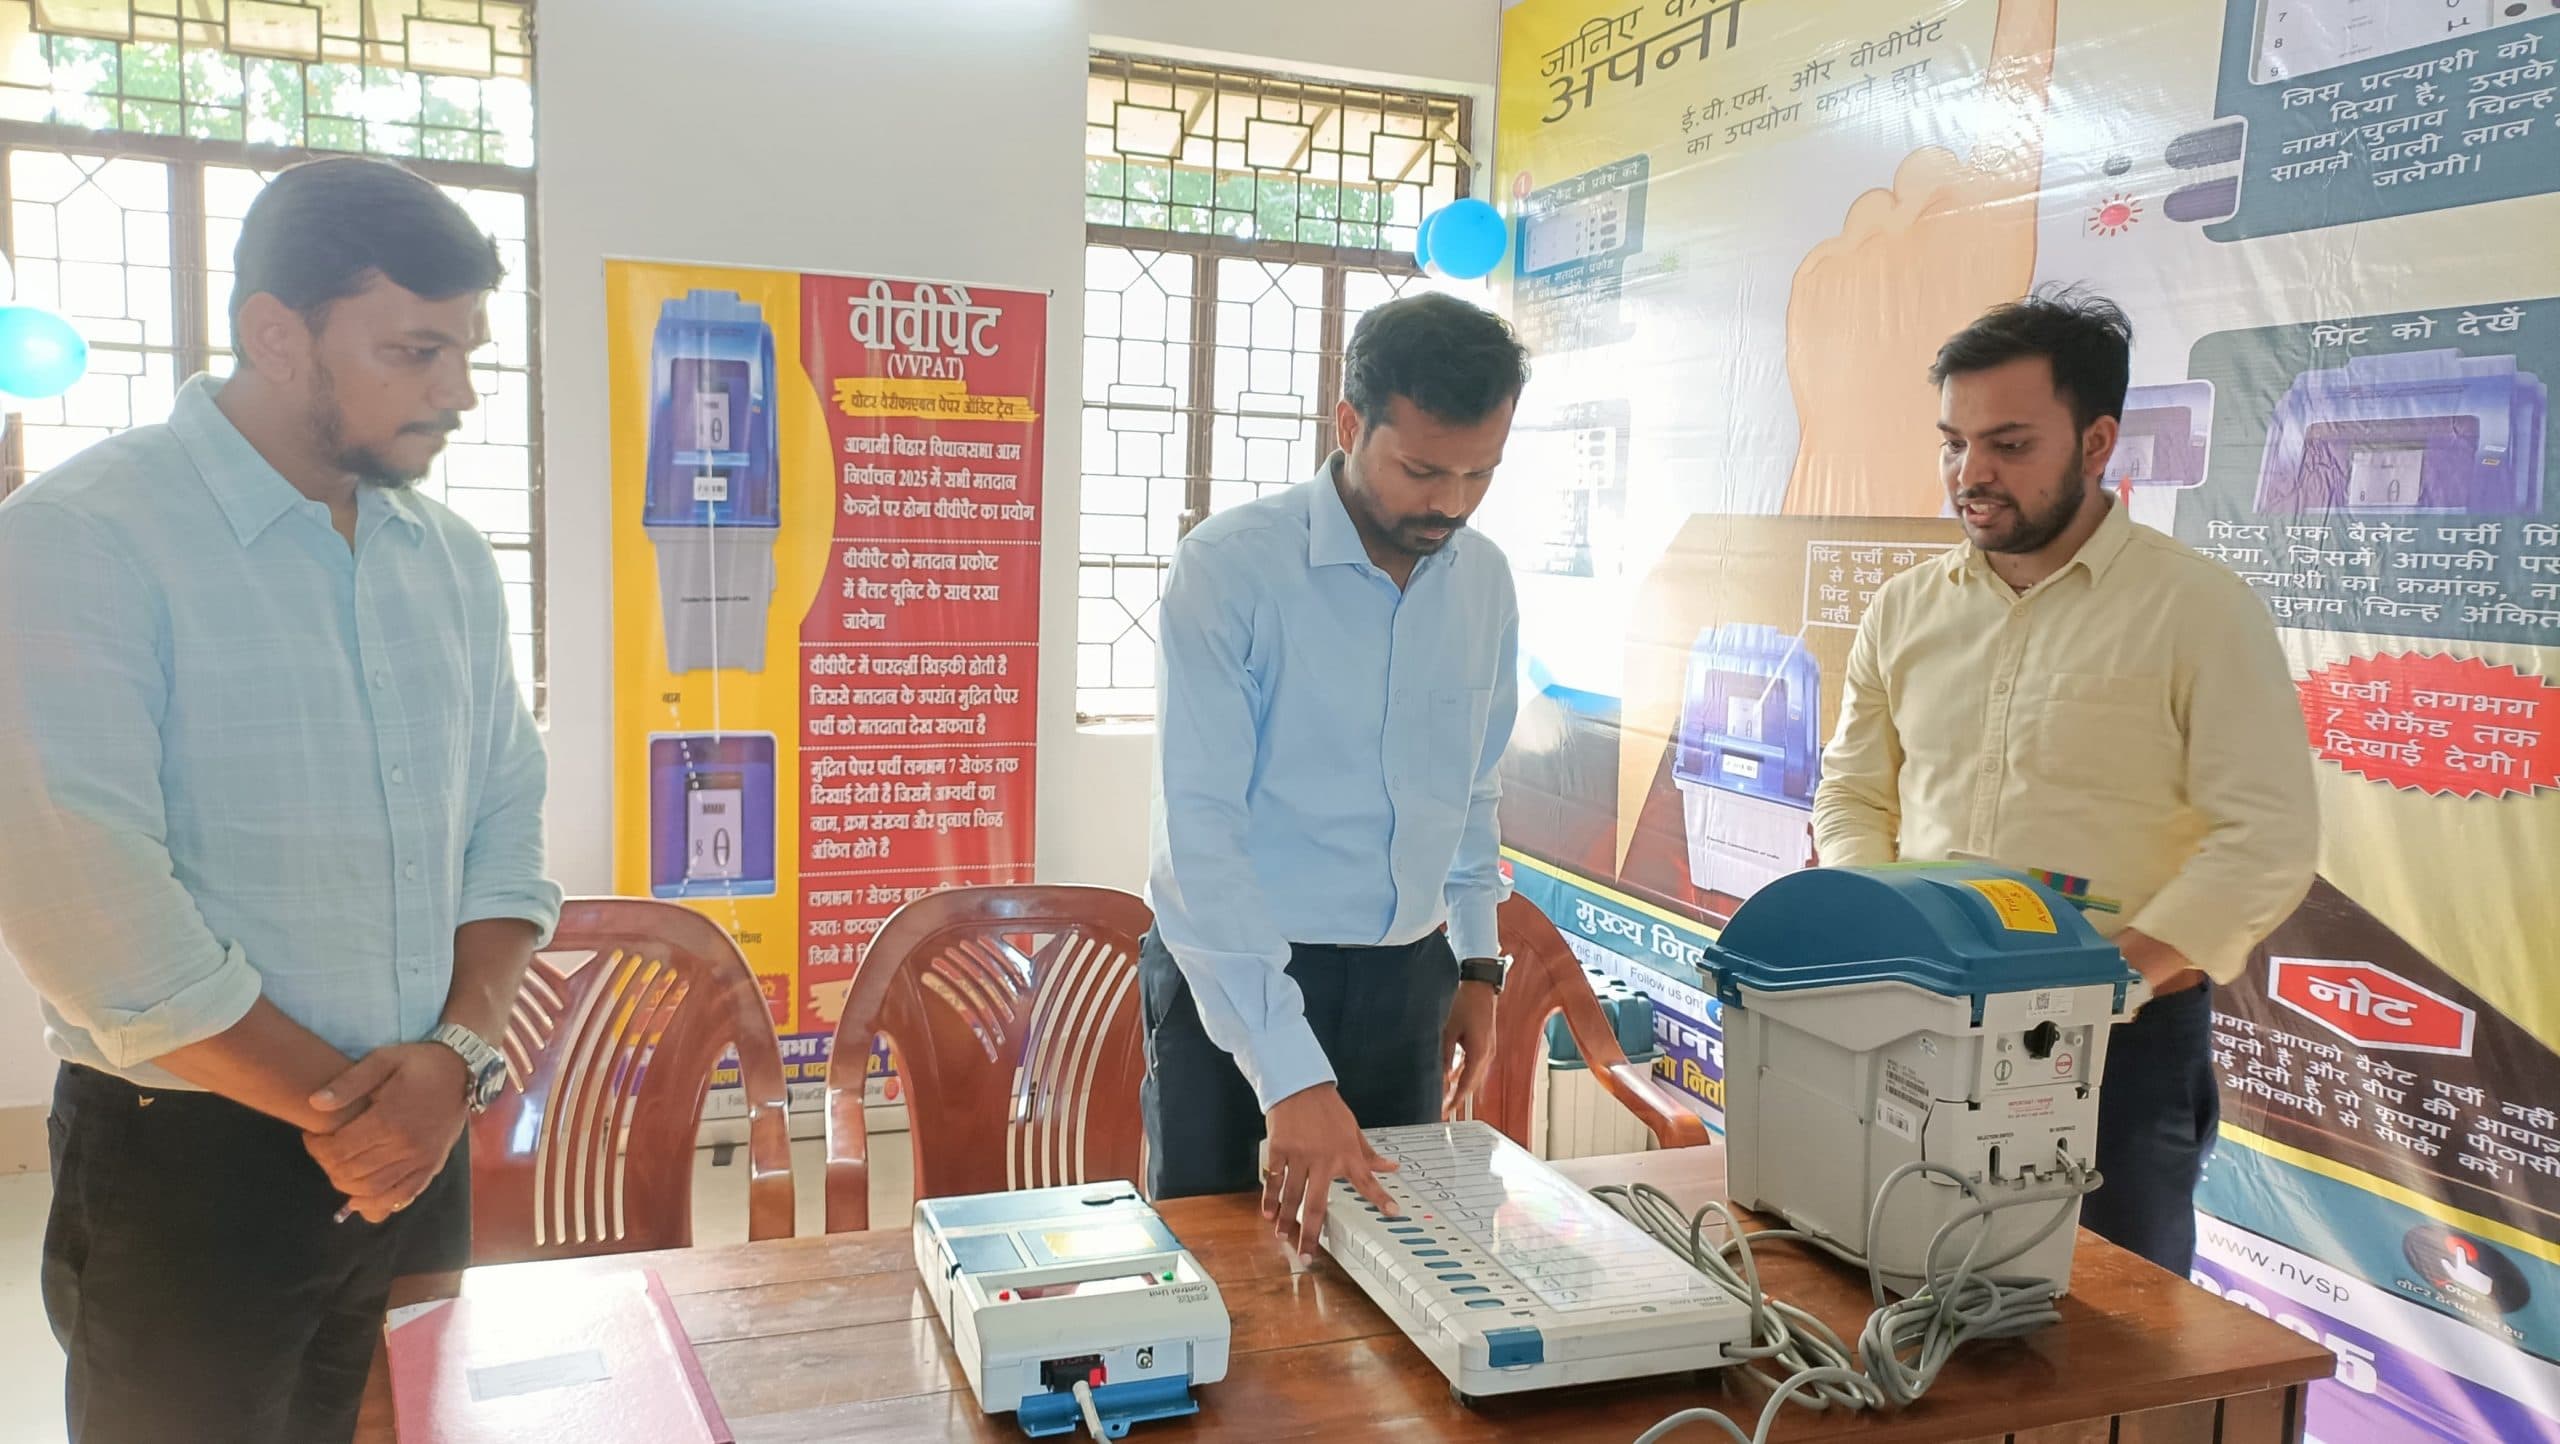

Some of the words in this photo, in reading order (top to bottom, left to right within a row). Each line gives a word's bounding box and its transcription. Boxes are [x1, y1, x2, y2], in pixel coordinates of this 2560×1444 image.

[2278, 11, 2287, 22] 7
[1541, 6, 1644, 77] जानिए
[2274, 37, 2284, 49] 8
[1542, 0, 1750, 123] अपना
[2281, 83, 2344, 110] जिस
[2361, 48, 2479, 93] प्रत्याशी
[2498, 33, 2544, 60] को
[1790, 59, 1835, 92] और
[2330, 94, 2398, 123] दिया
[2468, 58, 2558, 93] उसके
[2467, 87, 2557, 120] चिन्ह
[1687, 133, 1713, 156] का
[1725, 102, 1802, 144] उपयोग
[2272, 150, 2353, 182] सामने
[2370, 133, 2443, 163] वाली
[2462, 118, 2535, 147] लाल
[2311, 322, 2372, 349] प्रिंट
[2391, 315, 2437, 340] को
[2456, 306, 2526, 338] देखें
[888, 354, 964, 382] (VVPAT)
[939, 395, 960, 413] पेपर
[845, 433, 889, 455] आगामी
[893, 434, 927, 457] बिहार
[930, 435, 993, 460] विधानसभा
[996, 443, 1021, 460] आम
[844, 463, 895, 486] निर्वाचन
[898, 469, 928, 488] 2025
[930, 466, 941, 488] में
[944, 467, 970, 489] सभी
[973, 473, 1017, 490] मतदान
[883, 500, 901, 517] पर
[903, 496, 931, 519] होगा
[981, 503, 998, 520] का
[1001, 498, 1035, 521] प्रयोग
[2207, 520, 2269, 541] प्रिंटर
[2286, 525, 2332, 541] एक
[2347, 521, 2419, 543] बैलेट
[2437, 523, 2502, 545] पर्ची
[891, 548, 910, 569] को
[912, 553, 957, 570] मतदान
[1811, 546, 1841, 563] प्रिंट
[1852, 548, 1883, 564] पर्ची
[1892, 549, 1917, 565] को
[2288, 545, 2376, 567] जिसमें
[2392, 549, 2499, 571] आपकी
[1830, 566, 1844, 582] से
[1854, 567, 1884, 585] देखें
[2234, 570, 2326, 590] त्याशी
[2341, 576, 2380, 592] का
[843, 577, 855, 599] में
[857, 577, 887, 599] बैलट
[891, 579, 924, 606] यूनिट
[927, 579, 941, 600] के
[944, 584, 970, 600] साथ
[973, 584, 999, 601] रखा
[1820, 584, 1850, 602] प्रिंट
[843, 608, 886, 630] जायेगा
[1821, 606, 1851, 624] नहीं
[2271, 596, 2347, 618] चुनाव
[2363, 596, 2442, 623] चिन्ह
[858, 654, 870, 676] में
[872, 654, 919, 676] पारदर्शी
[920, 654, 966, 678] खिड़की
[969, 654, 995, 676] होती
[998, 653, 1007, 676] है
[809, 684, 849, 706] जिससे
[852, 688, 897, 705] मतदान
[900, 684, 915, 705] के
[918, 684, 955, 705] उपरांत
[958, 685, 991, 711] मुद्रित
[994, 684, 1019, 704] पेपर
[2330, 680, 2392, 703] पर्ची
[2411, 689, 2540, 719] लगभग
[810, 714, 835, 735] पर्ची
[837, 714, 856, 735] को
[858, 718, 907, 735] मतदाता
[909, 714, 932, 735] देख
[936, 717, 974, 734] सकता
[976, 713, 986, 735] है
[2326, 707, 2343, 724] 7
[2473, 724, 2541, 748] तक
[2324, 729, 2424, 767] दिखाई
[811, 757, 846, 783] मुद्रित
[849, 756, 875, 776] पेपर
[877, 755, 901, 775] पर्ची
[904, 758, 946, 775] लगभग
[949, 758, 956, 774] 7
[996, 757, 1019, 773] तक
[811, 783, 852, 805] दिखाई
[855, 783, 879, 804] देती
[881, 782, 892, 804] है
[895, 782, 931, 803] जिसमें
[978, 784, 996, 801] का
[844, 814, 868, 831] क्रम
[871, 811, 909, 830] संख्या
[912, 809, 934, 829] और
[937, 812, 971, 834] चुनाव
[973, 808, 1004, 828] चिन्ह
[812, 839, 850, 859] अंकित
[853, 838, 877, 859] होते
[809, 889, 852, 907] लगभग
[856, 889, 864, 905] 7
[1576, 899, 1645, 946] मुख्य
[843, 944, 855, 963] में
[1630, 965, 1665, 991] Follow
[1668, 987, 1682, 1000] us
[2307, 975, 2418, 1027] नोट
[2269, 1029, 2344, 1063] आपको
[2356, 1054, 2418, 1086] बैलेट
[2432, 1079, 2485, 1108] पर्ची
[2502, 1101, 2559, 1130] नहीं
[2277, 1047, 2293, 1067] है
[2306, 1060, 2350, 1086] और
[2361, 1078, 2407, 1104] बीप
[2423, 1098, 2460, 1120] की
[2248, 1057, 2292, 1085] देती
[2304, 1075, 2322, 1097] है
[2334, 1088, 2363, 1109] तो
[2375, 1103, 2451, 1139] कृपया
[2225, 1073, 2326, 1117] अधिकारी
[2339, 1110, 2361, 1129] से
[2375, 1123, 2441, 1157] संपर्क
